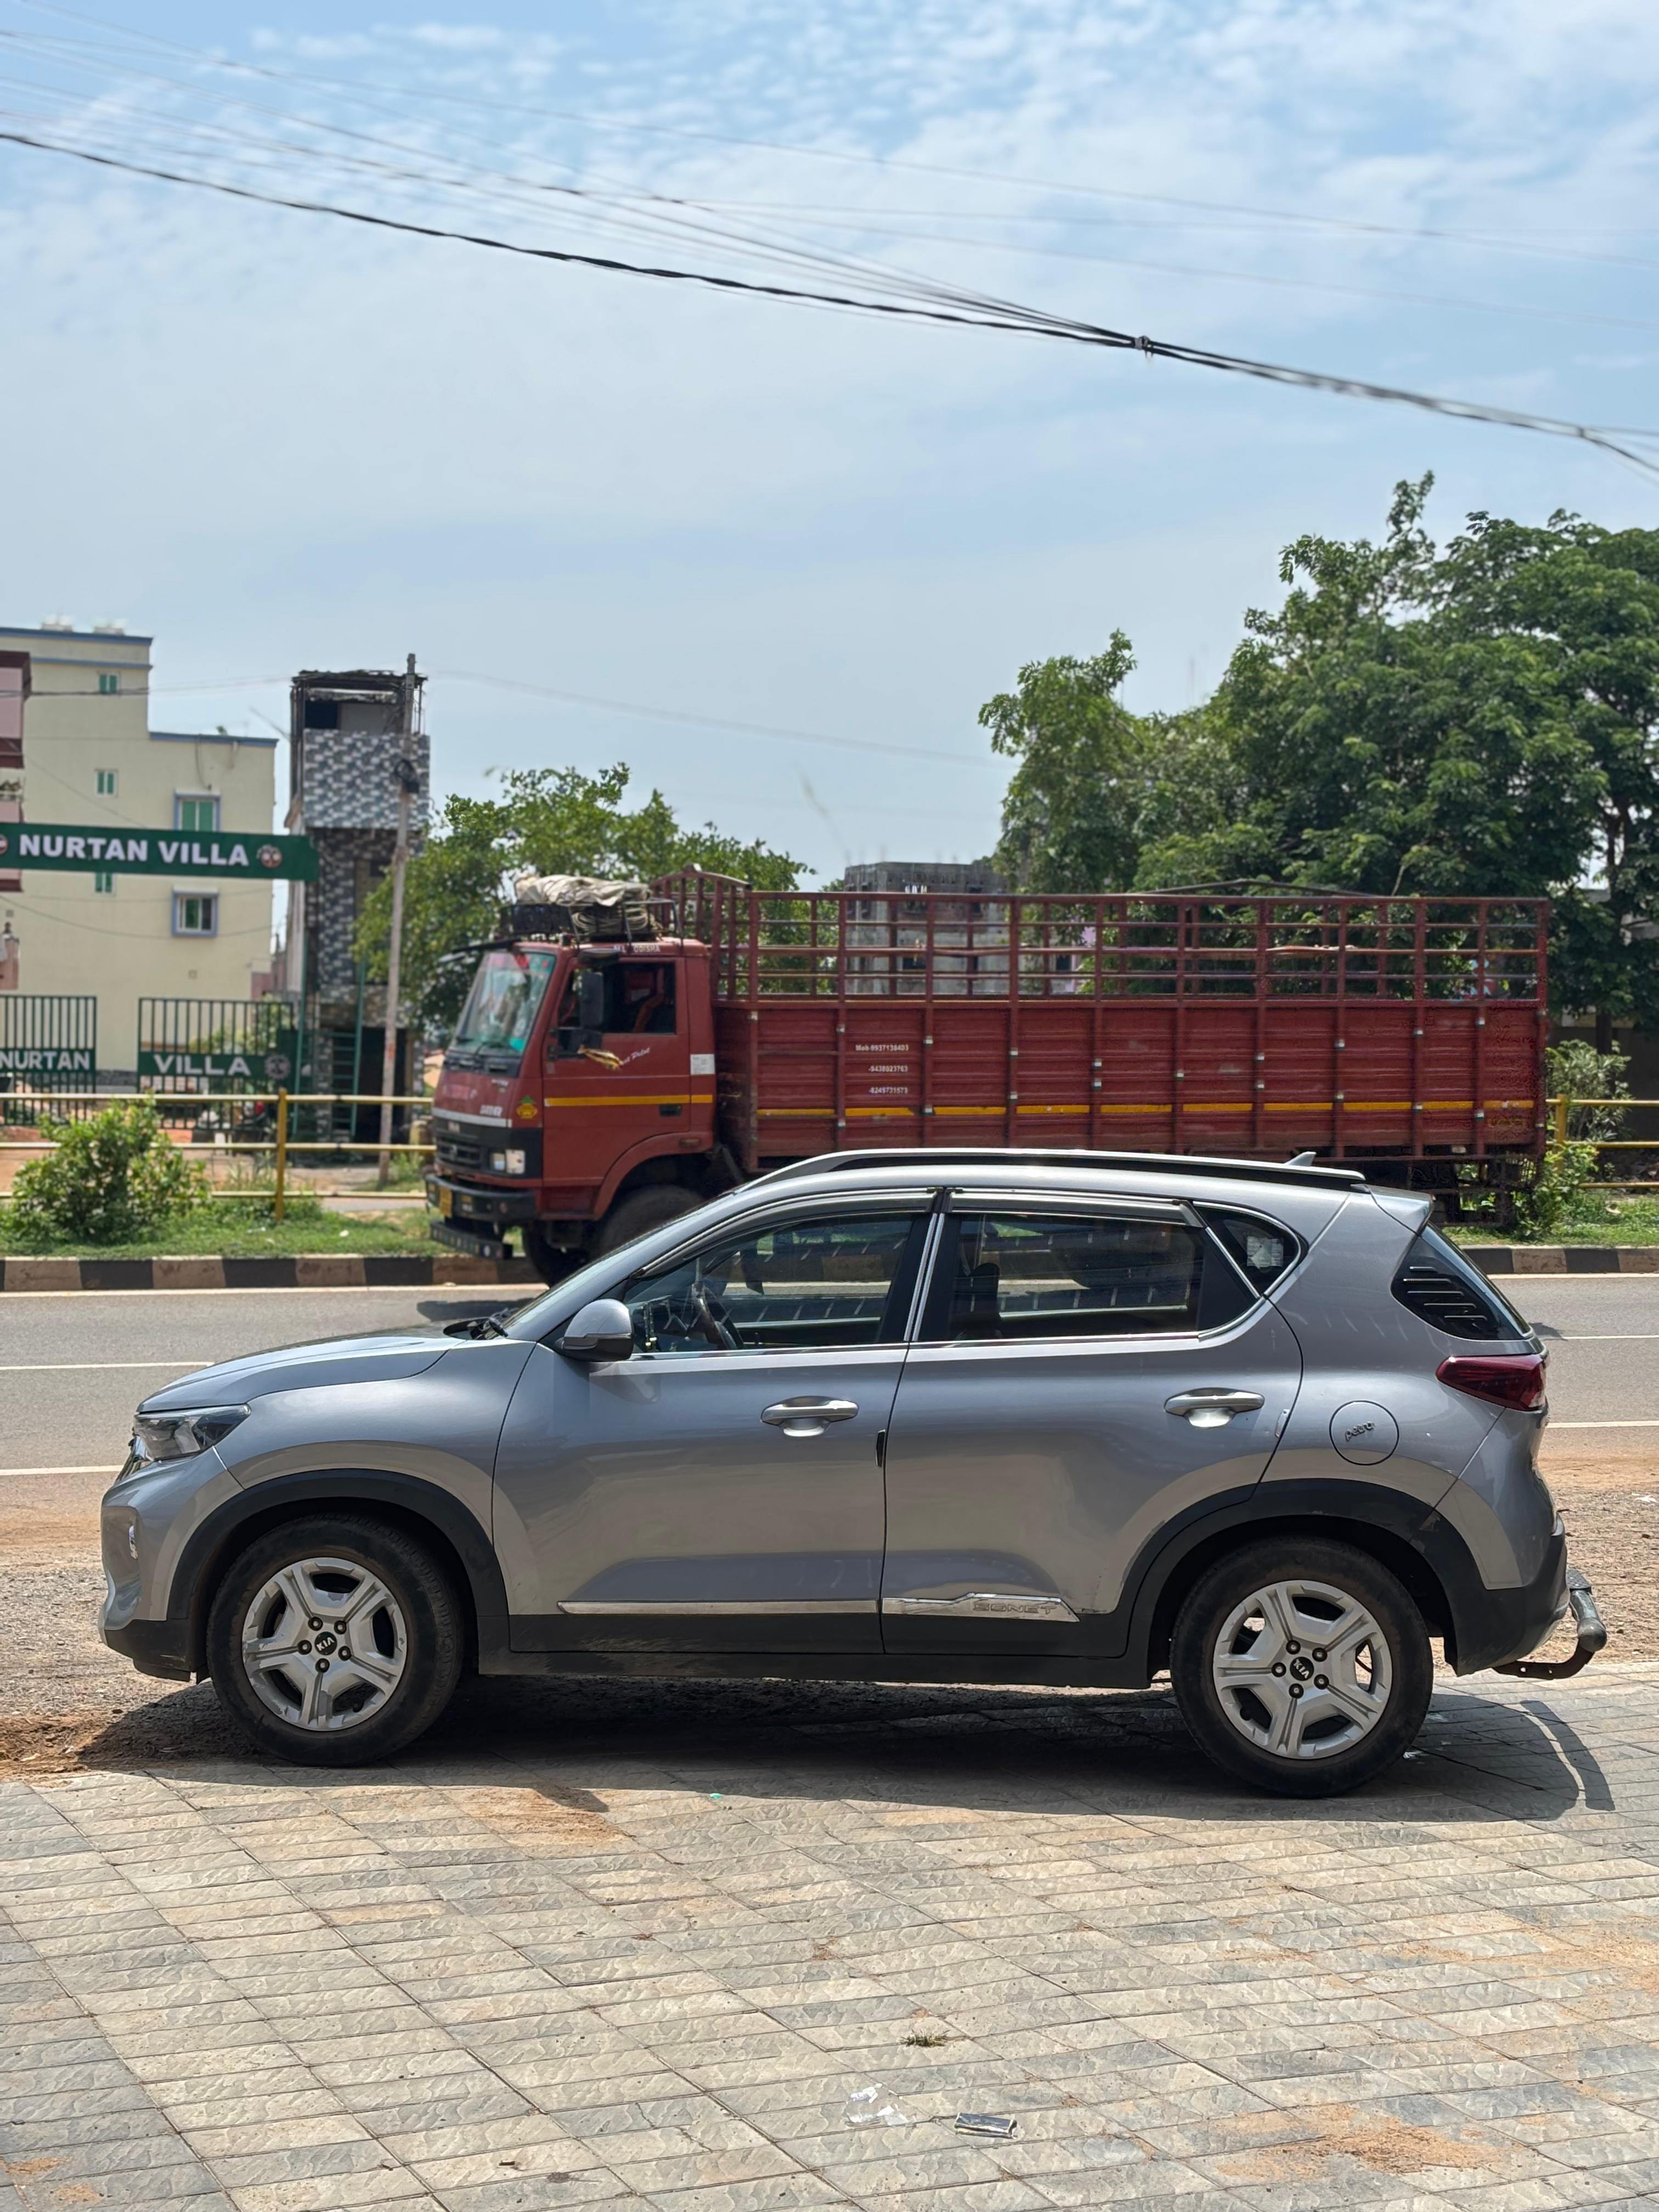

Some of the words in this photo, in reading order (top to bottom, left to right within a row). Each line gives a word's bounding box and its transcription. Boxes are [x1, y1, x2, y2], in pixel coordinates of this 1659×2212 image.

[19, 834, 148, 861] NURTAN
[157, 841, 250, 867] VILLA
[0, 1050, 91, 1070] NURTAN
[154, 1053, 252, 1076] VILLA
[973, 1602, 1057, 1615] SONET
[317, 1637, 335, 1651] KIA
[1293, 1658, 1310, 1679] KIA
